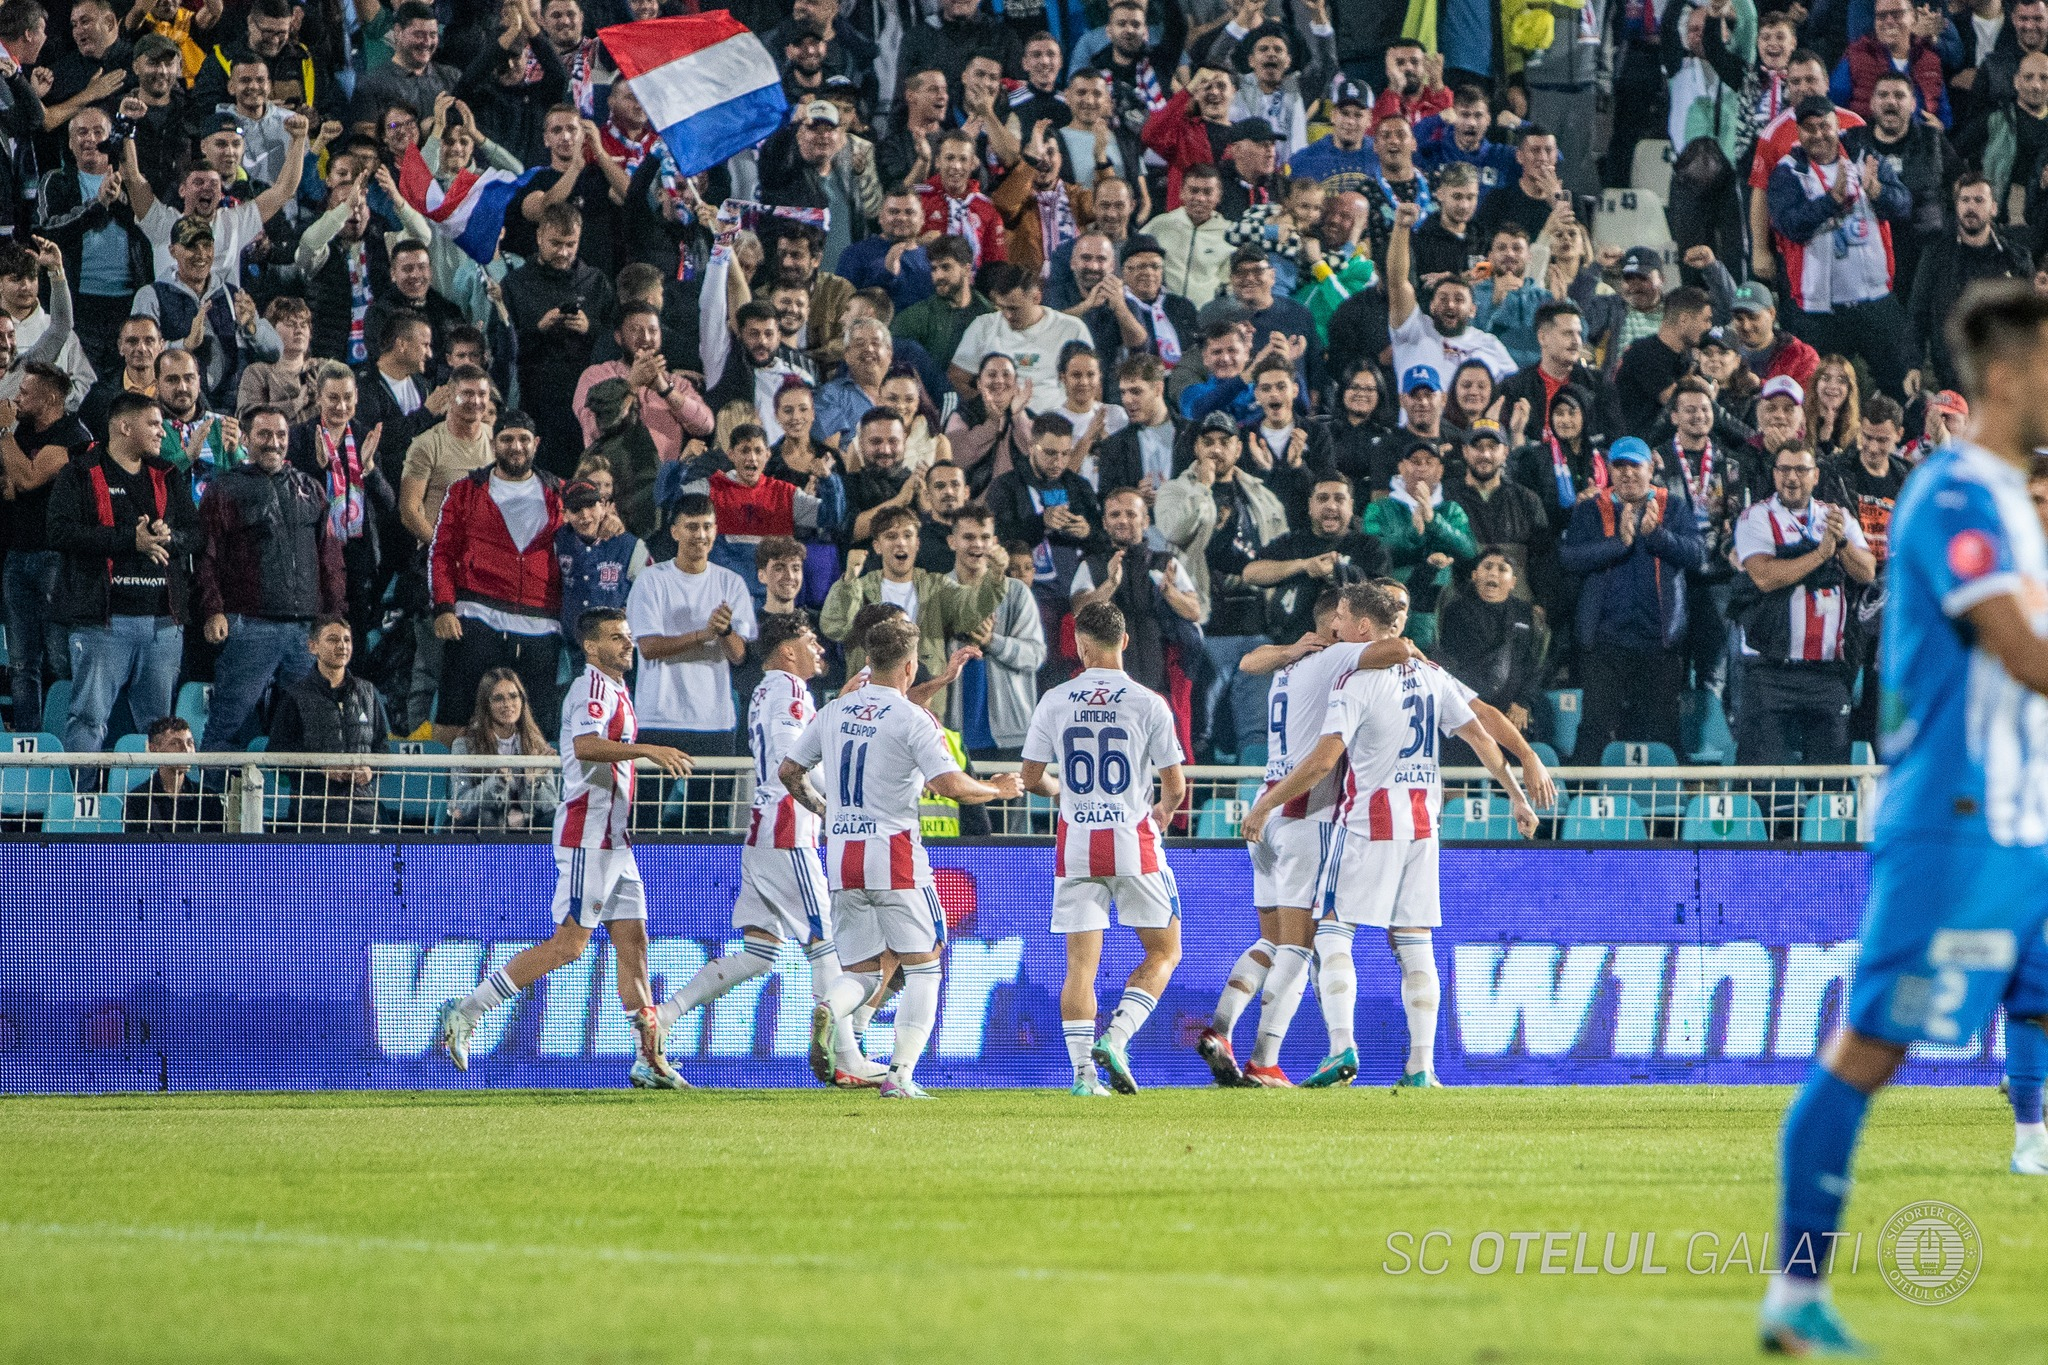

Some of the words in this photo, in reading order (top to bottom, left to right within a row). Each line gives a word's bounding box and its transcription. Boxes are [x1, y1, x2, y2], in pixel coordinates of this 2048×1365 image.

[1074, 710, 1116, 723] LAMEIRA
[1270, 691, 1288, 755] 9
[1399, 694, 1435, 758] 31
[16, 739, 35, 753] 17
[1632, 746, 1641, 764] 4
[1062, 727, 1130, 795] 66
[840, 740, 868, 808] 11
[78, 797, 95, 816] 17
[1472, 801, 1482, 820] 6
[1717, 798, 1725, 816] 4
[1838, 798, 1848, 817] 3
